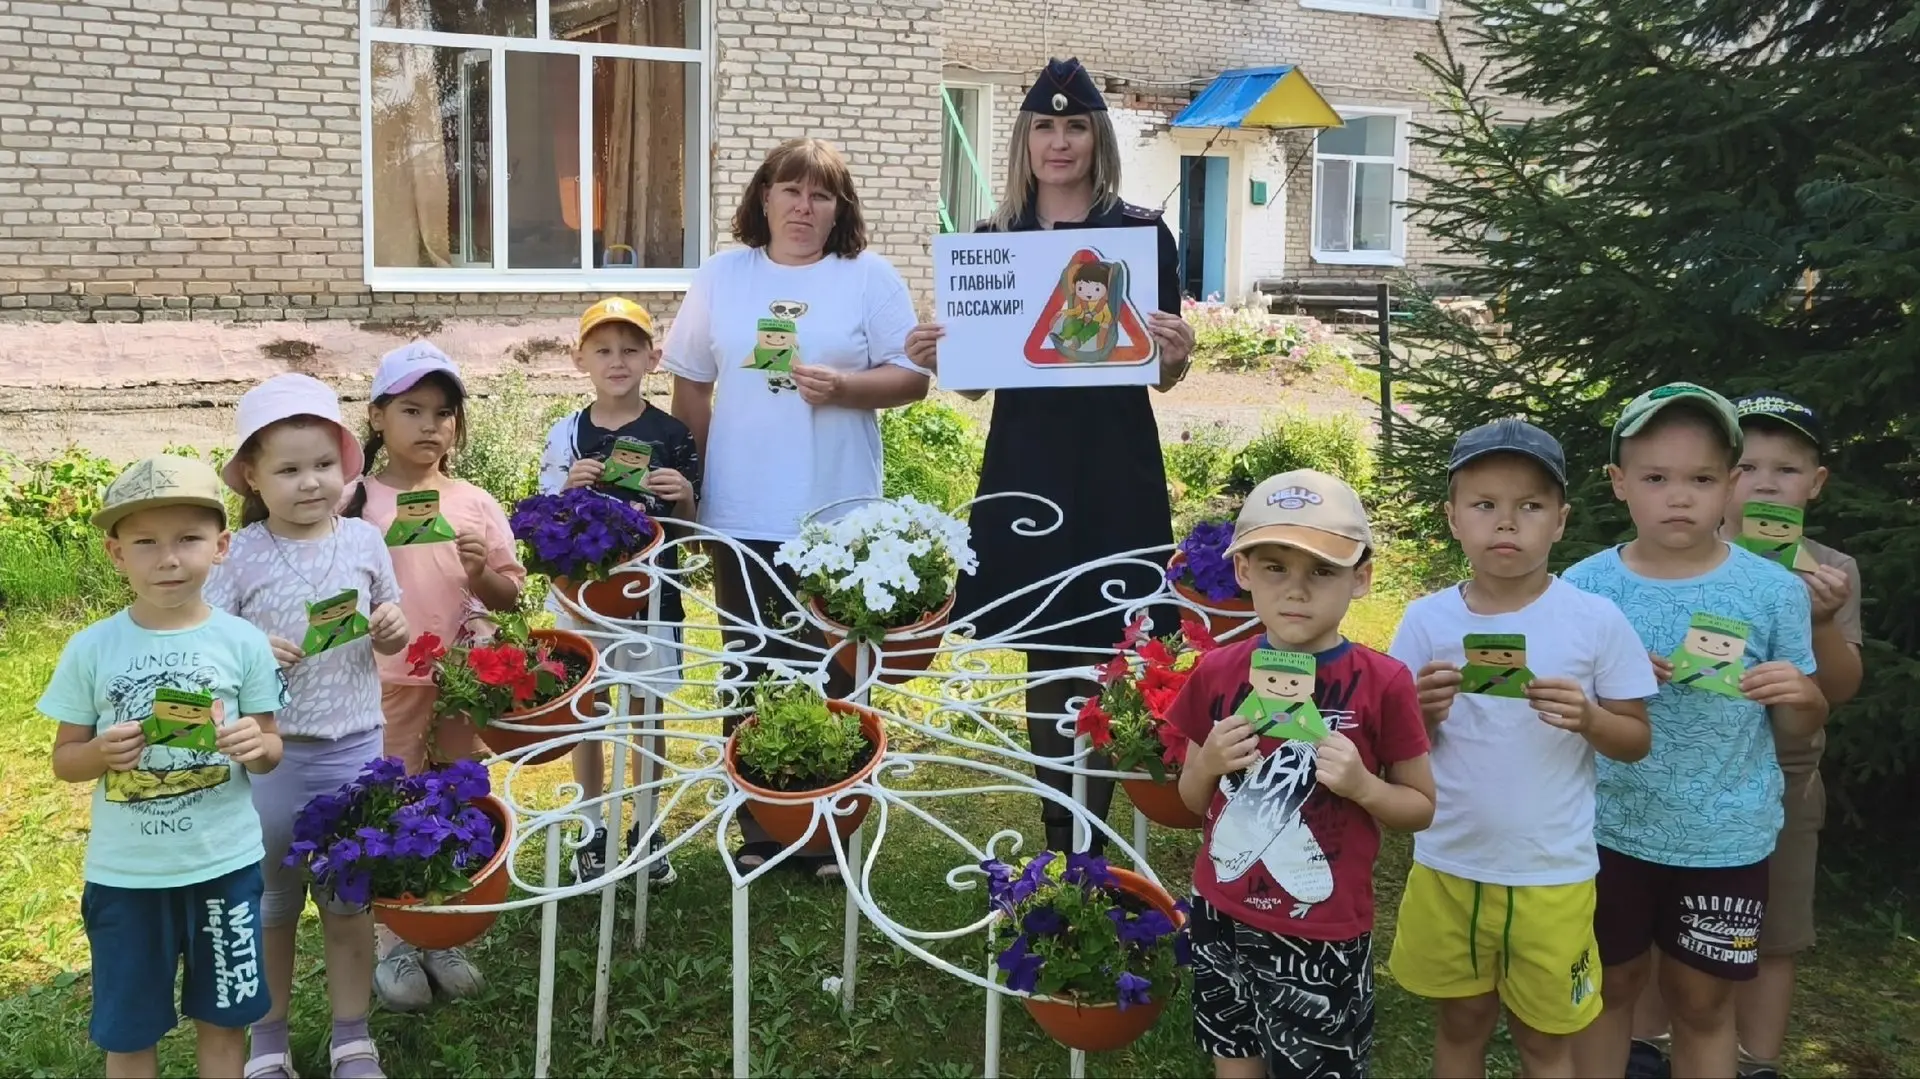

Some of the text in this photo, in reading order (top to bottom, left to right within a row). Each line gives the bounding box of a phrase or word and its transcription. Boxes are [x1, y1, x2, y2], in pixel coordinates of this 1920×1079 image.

[951, 248, 1016, 266] РЕБЕНОК-
[950, 270, 1016, 291] ГЛАВНЫЙ
[947, 299, 1025, 317] ПАССАЖИР!
[1267, 486, 1323, 505] HELLO
[126, 652, 200, 673] JUNGLE
[141, 816, 193, 836] KING
[1680, 913, 1760, 938] National
[202, 898, 237, 1008] inspiration
[228, 901, 259, 1004] WATER
[1678, 932, 1758, 964] CHAMPIONS
